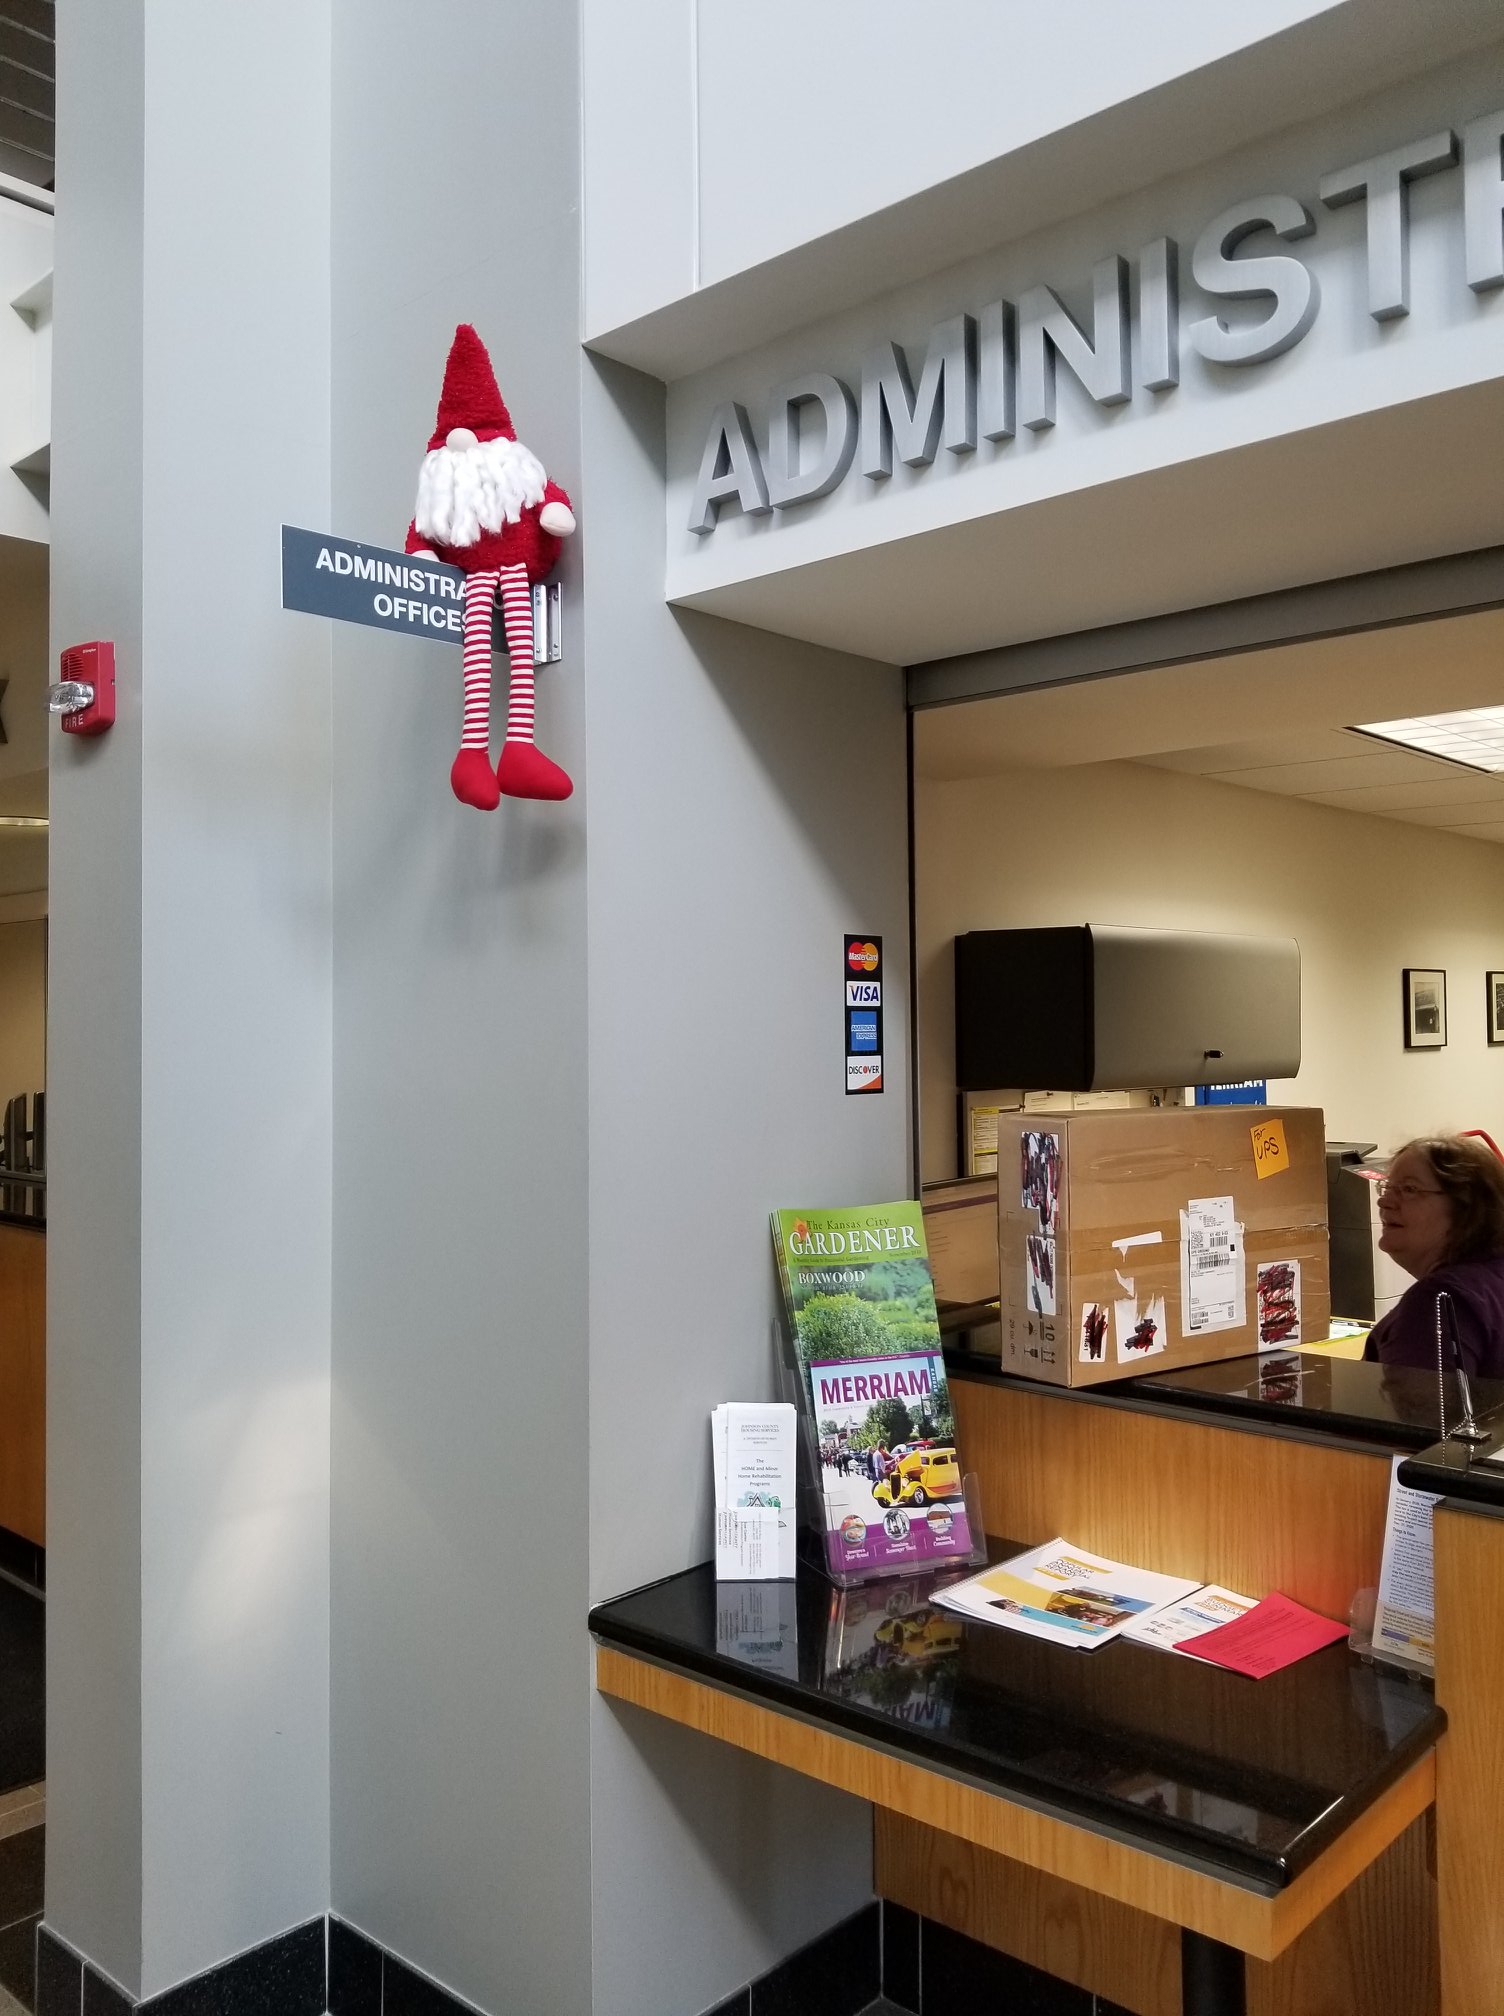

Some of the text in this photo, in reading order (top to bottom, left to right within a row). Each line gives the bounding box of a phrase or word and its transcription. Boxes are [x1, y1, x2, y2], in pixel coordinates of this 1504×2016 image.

[65, 714, 84, 728] FIRE
[848, 985, 879, 1002] VISA
[848, 1066, 880, 1074] DISCOVER
[1254, 1128, 1266, 1140] For
[1256, 1136, 1279, 1160] UPS
[806, 1218, 890, 1230] The Kansas City
[789, 1225, 920, 1255] GARDENER
[798, 1270, 866, 1284] BOXWOOD
[1045, 1324, 1055, 1342] 10
[820, 1368, 930, 1404] MERRIAM
